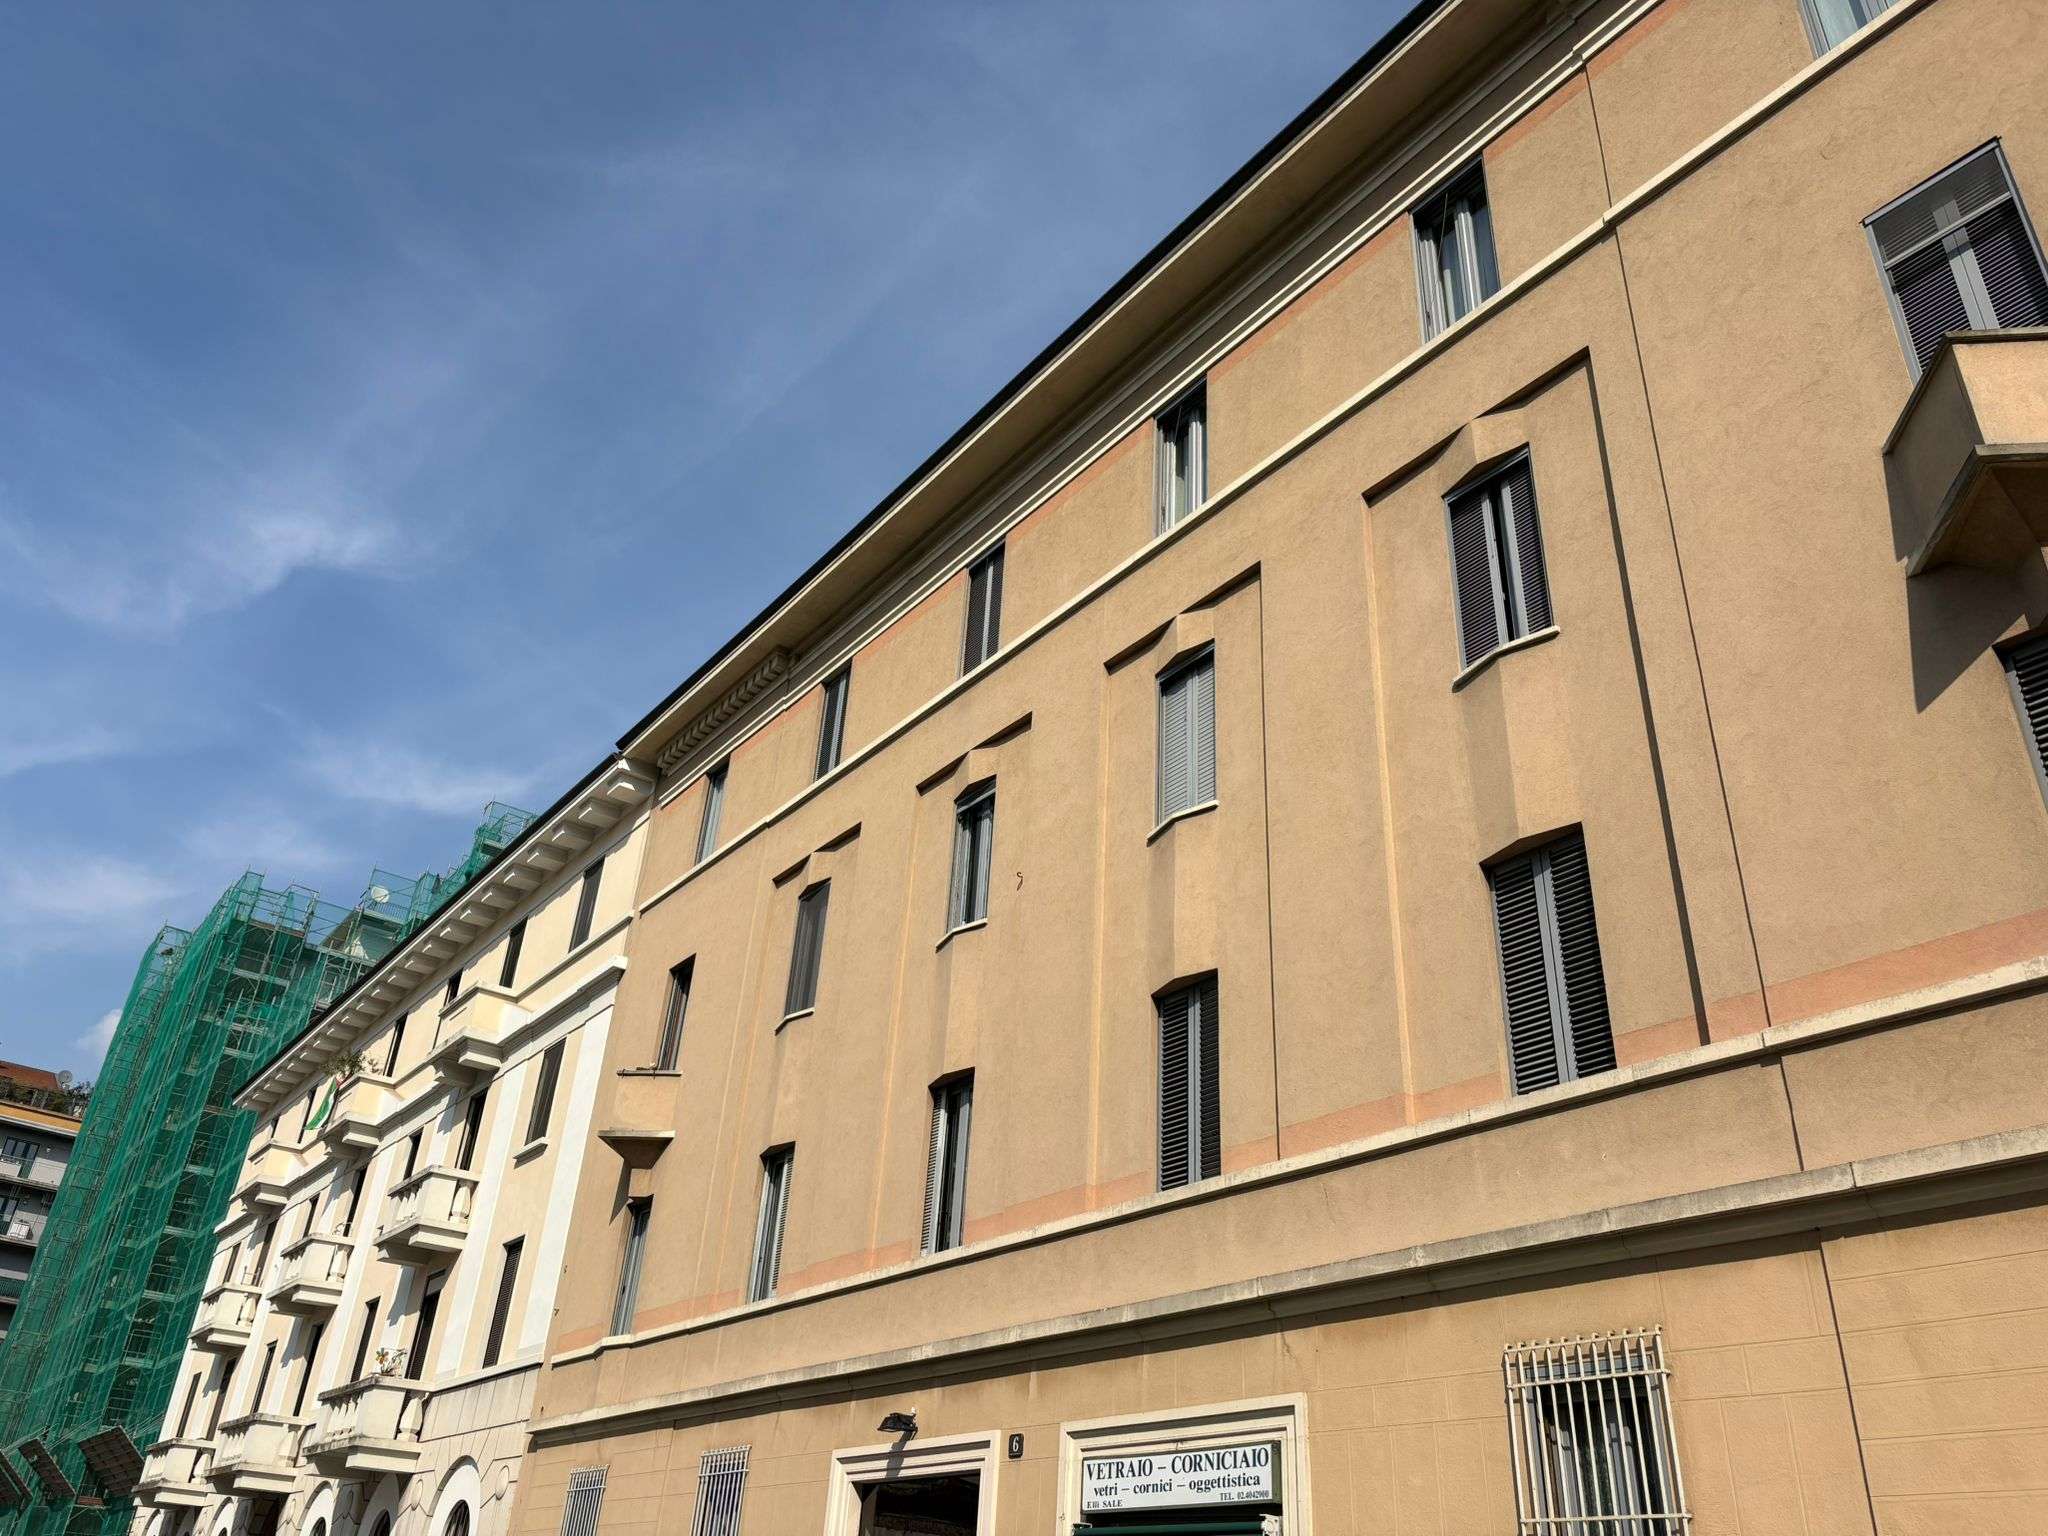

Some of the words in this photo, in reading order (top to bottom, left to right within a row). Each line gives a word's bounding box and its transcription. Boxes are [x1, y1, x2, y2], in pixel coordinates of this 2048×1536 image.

[1012, 1436, 1019, 1452] 6
[1087, 1458, 1153, 1480] VETRAIO
[1171, 1447, 1269, 1474] CORNICIAIO
[1094, 1483, 1118, 1496] vetri
[1133, 1479, 1173, 1494] cornici
[1189, 1473, 1260, 1493] oggettistica
[1102, 1499, 1123, 1508] SALE
[1220, 1492, 1235, 1501] TEL.
